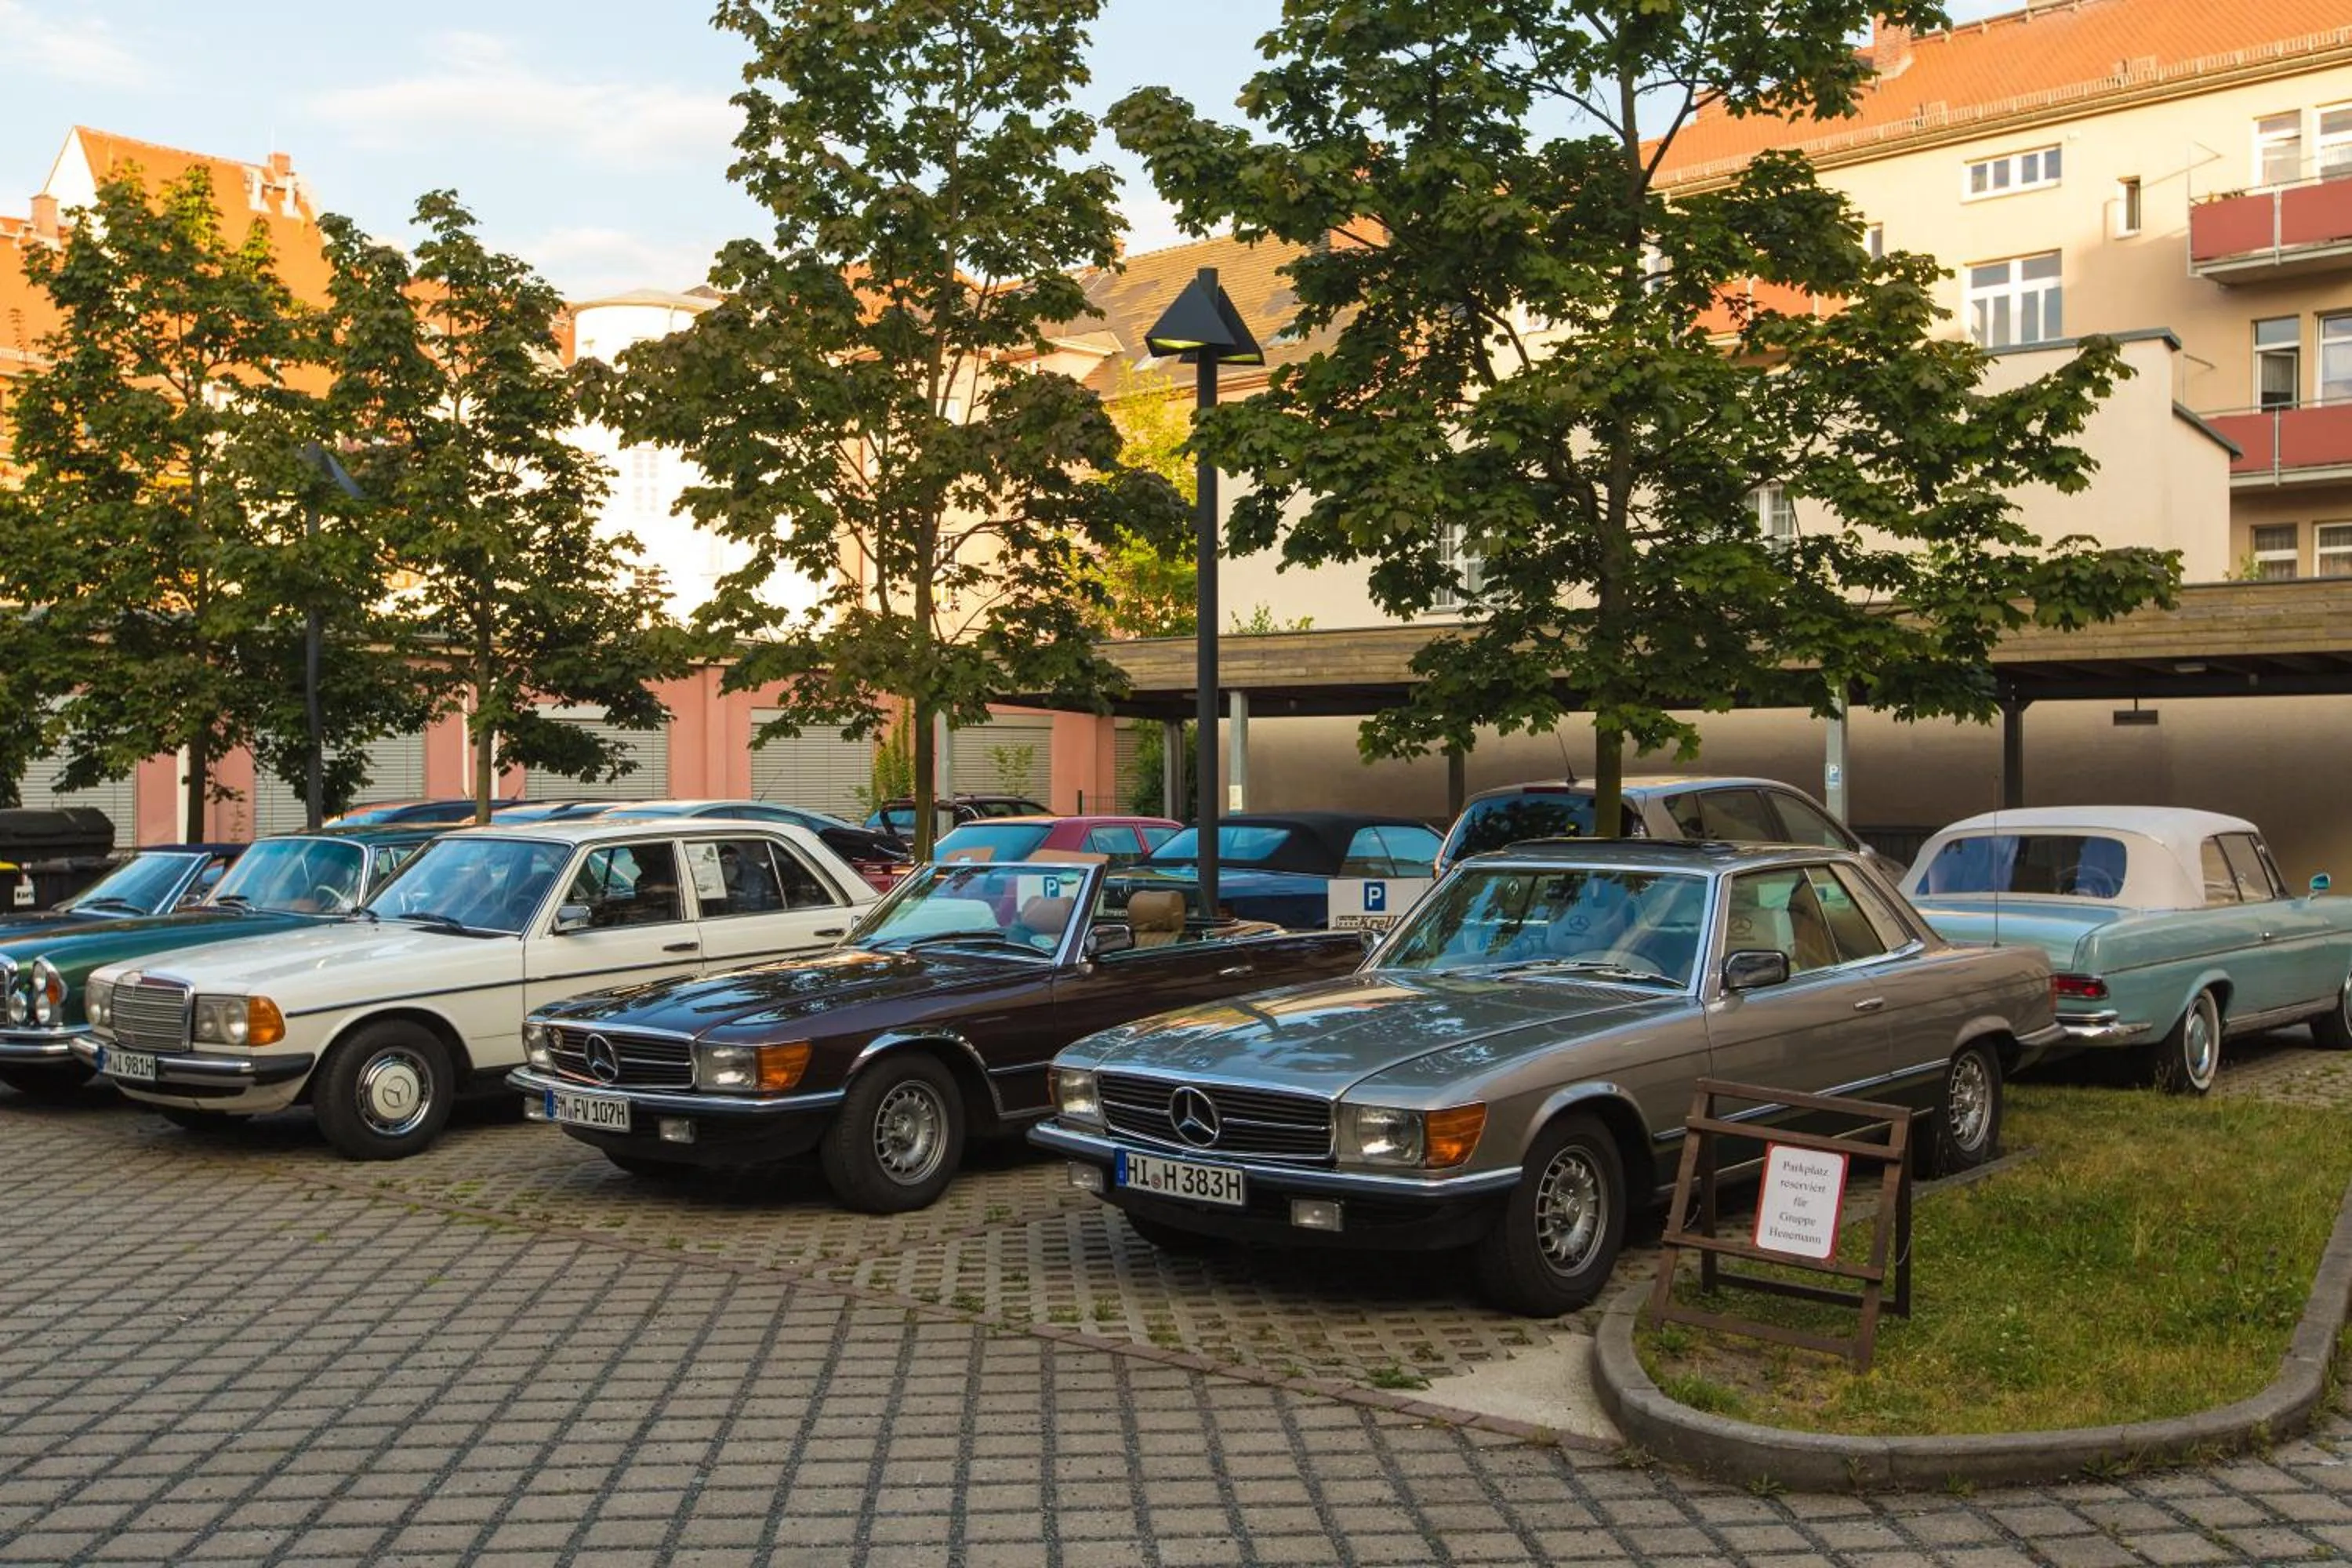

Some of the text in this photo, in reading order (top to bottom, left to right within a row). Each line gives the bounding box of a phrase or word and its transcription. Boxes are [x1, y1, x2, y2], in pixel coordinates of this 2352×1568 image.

[1047, 879, 1056, 898] P
[1368, 887, 1381, 907] P
[125, 1054, 154, 1077] 981H
[574, 1098, 589, 1121] FV
[592, 1101, 626, 1126] 107H
[1783, 1160, 1830, 1177] Parkplatz
[1127, 1157, 1240, 1201] HI H 383H
[1780, 1179, 1827, 1192] reserviert
[1779, 1211, 1817, 1226] Gruppe
